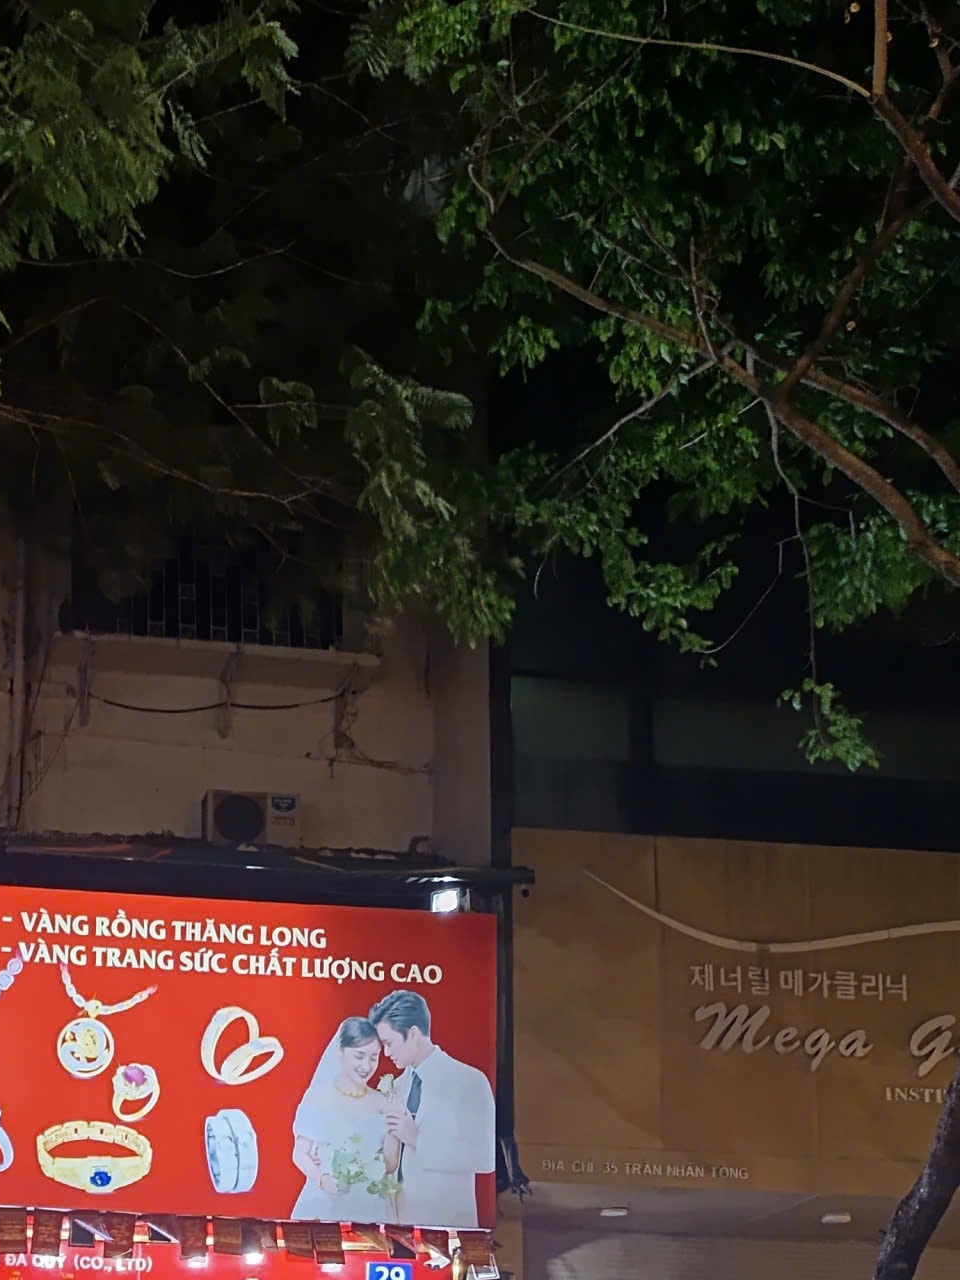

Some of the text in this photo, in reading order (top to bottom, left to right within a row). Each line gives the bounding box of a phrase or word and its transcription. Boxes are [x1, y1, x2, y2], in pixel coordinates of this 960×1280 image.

[20, 907, 89, 937] VÀNG
[94, 908, 166, 941] RỒNG
[171, 916, 254, 946] THĂNG
[260, 925, 328, 949] LONG
[19, 938, 87, 967] VÀNG
[92, 946, 175, 971] TRANG
[179, 946, 228, 974] SỨC
[232, 949, 297, 979] CHẤT
[301, 956, 386, 986] LƯỢNG
[390, 962, 443, 985] CAO
[694, 1001, 960, 1078] Mega G
[603, 1162, 618, 1175] 35
